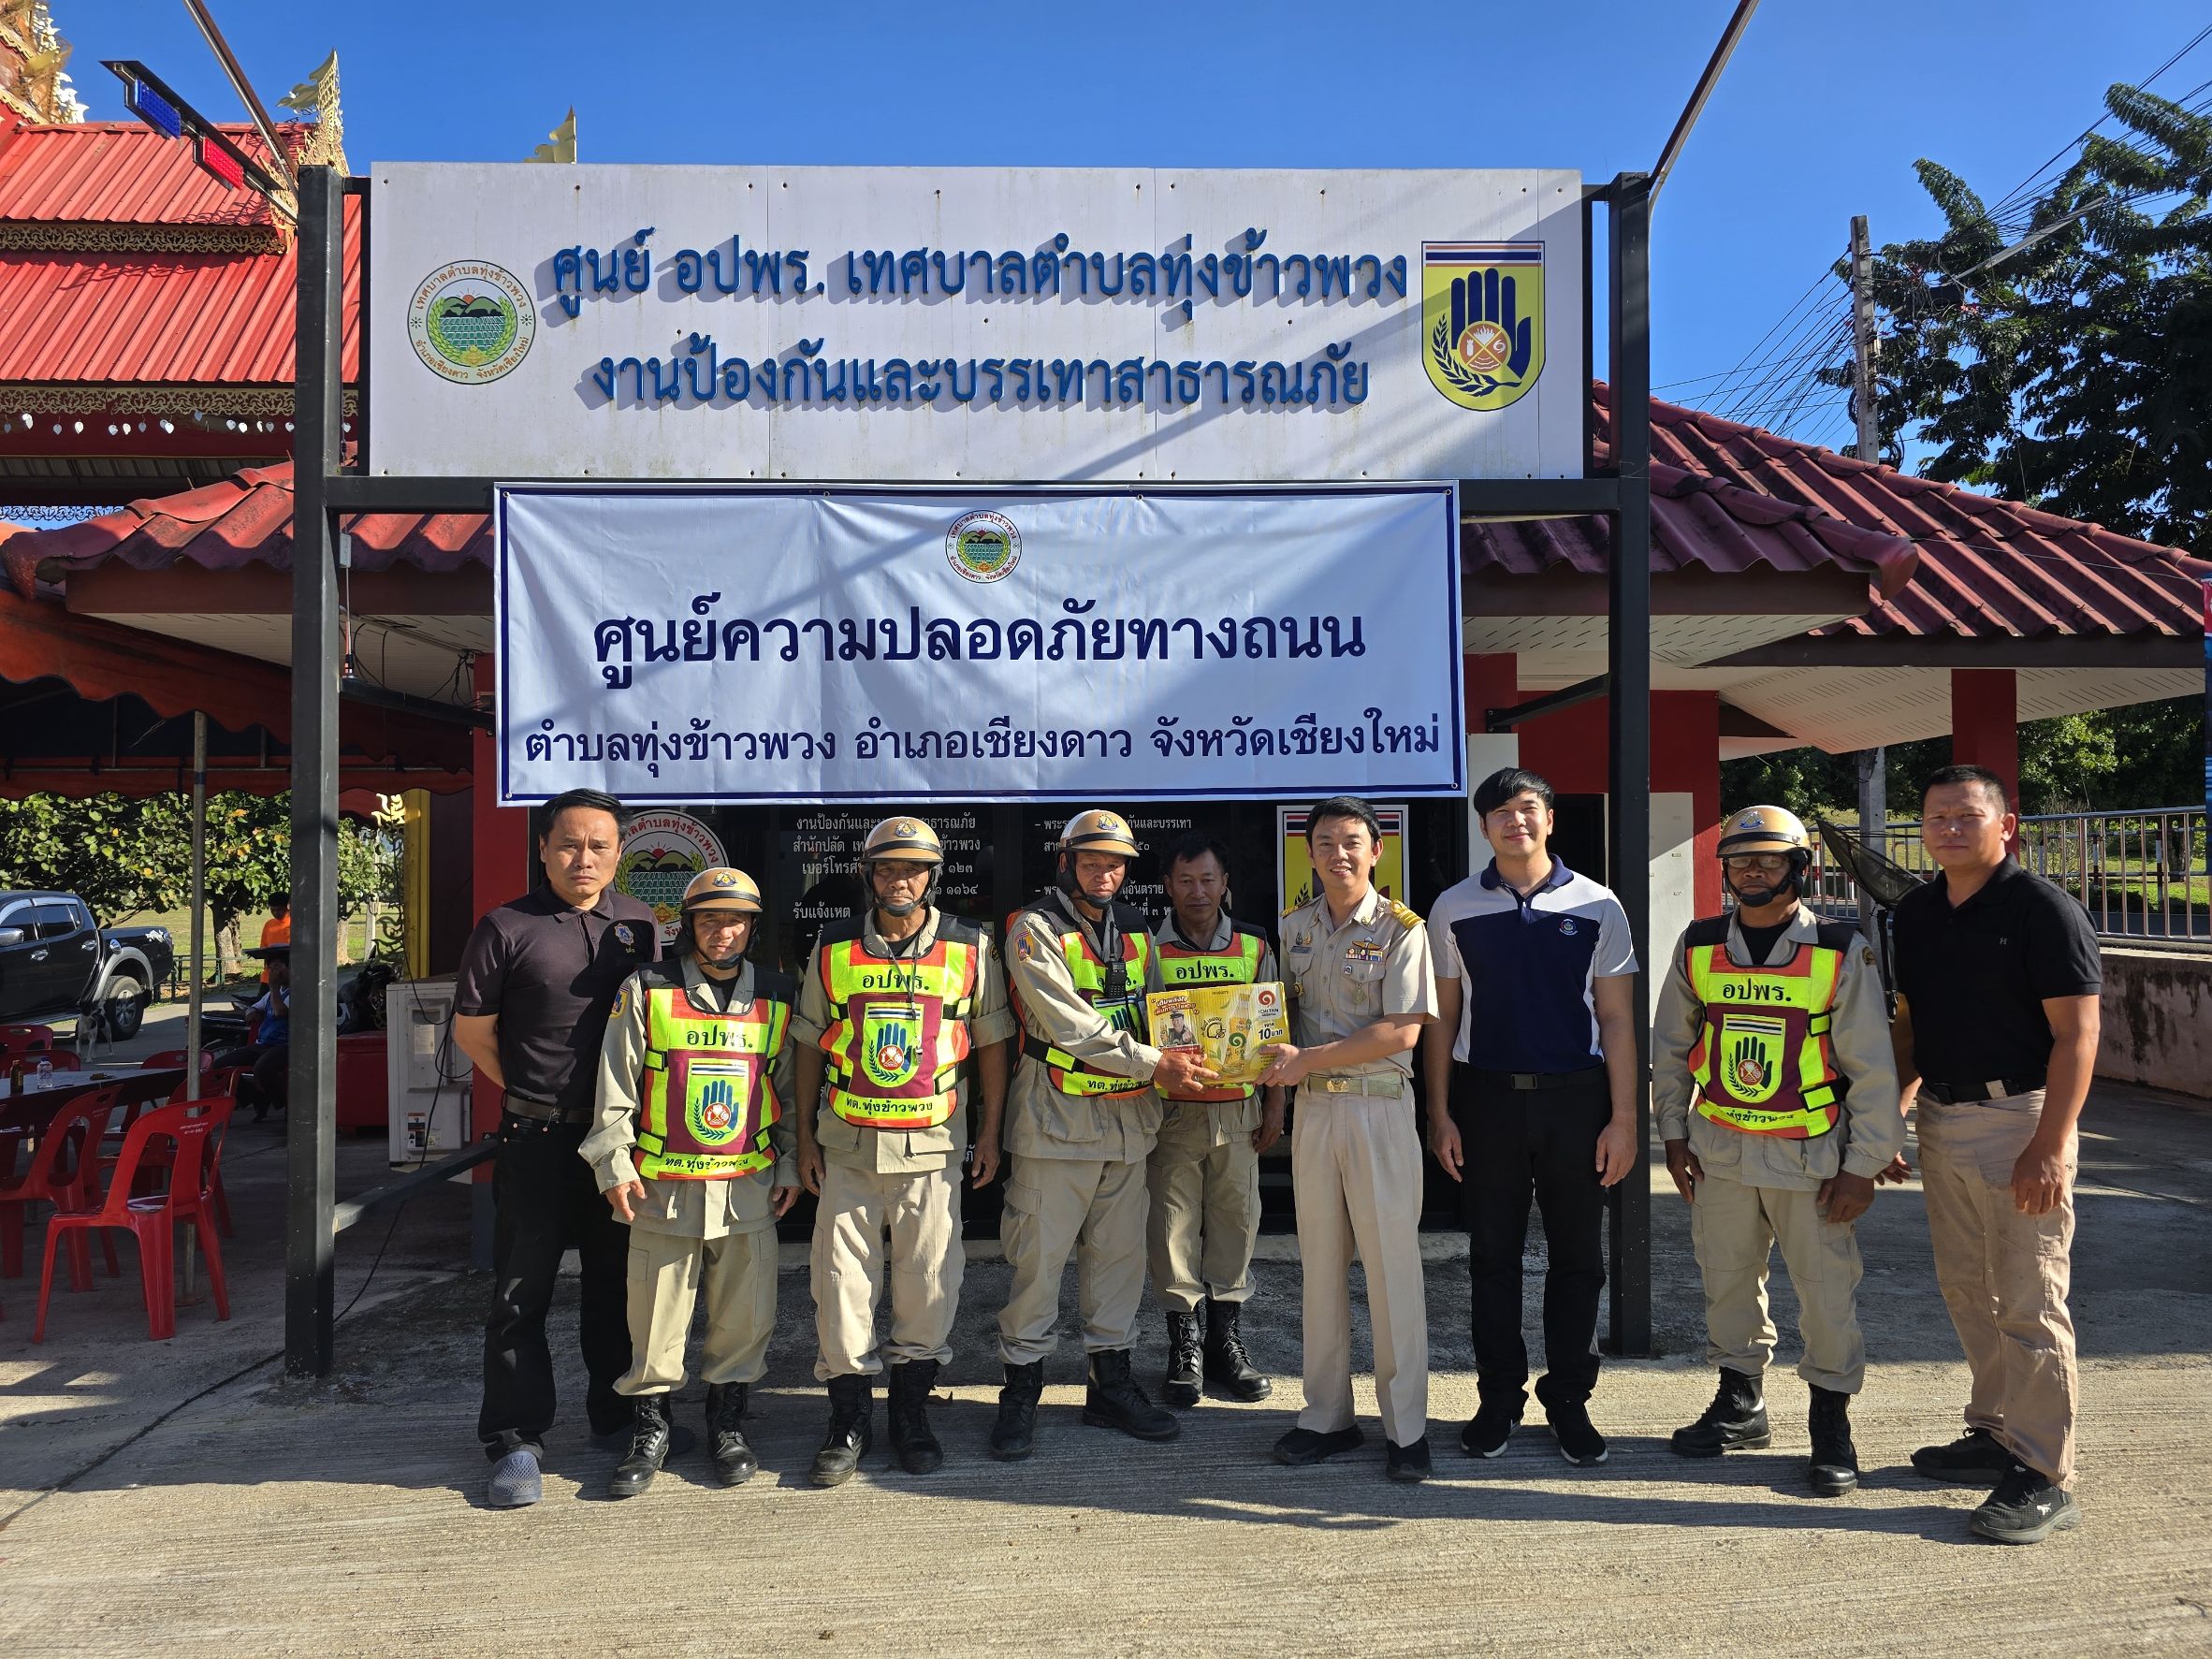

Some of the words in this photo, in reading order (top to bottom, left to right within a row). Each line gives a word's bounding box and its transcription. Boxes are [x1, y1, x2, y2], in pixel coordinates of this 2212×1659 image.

[415, 265, 527, 310] เทศบาลตำบลทุ่งข้าวพวง
[553, 228, 654, 317] ศูนย์
[675, 237, 826, 295] อปพร.
[846, 227, 1407, 319] เทศบาลตำบลทุ่งข้าวพวง
[415, 339, 469, 379] อำเภอเชียงดาว
[476, 336, 530, 379] จังหวัดเชียงใหม่
[592, 333, 1370, 407] งานป้องกันและบรรเทาสาธารณภัย
[593, 593, 1365, 688] ศูนย์ความปลอดภัยทางถนน
[524, 717, 836, 777] ตำบลทุ่งข้าวพวง
[855, 721, 1131, 763] อำเภอเชียงดาว
[1150, 707, 1438, 759] จังหวัดเชียงใหม่
[793, 835, 845, 852] สำนักปลัด
[948, 862, 973, 873] ๑๒๓
[862, 969, 930, 991] อปพร.
[1176, 961, 1234, 980] อปพร.
[1723, 978, 1792, 1002] อปพร.
